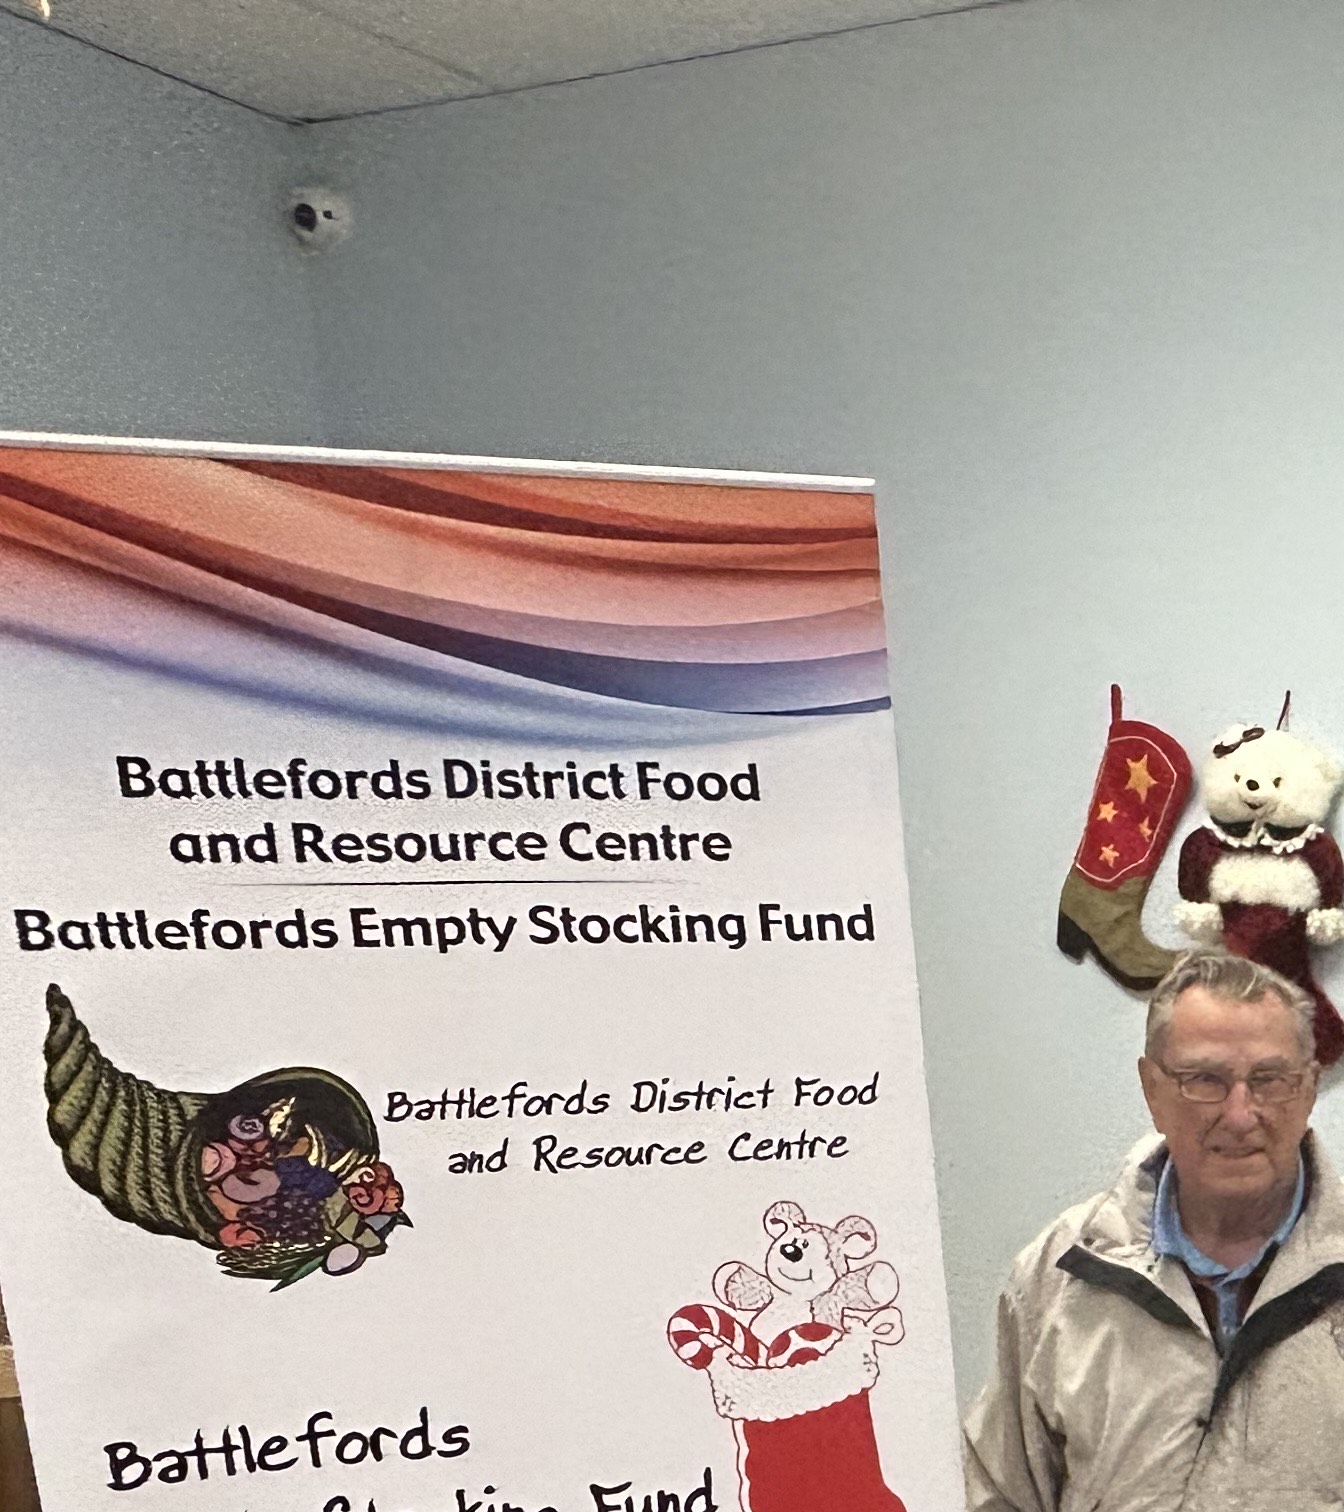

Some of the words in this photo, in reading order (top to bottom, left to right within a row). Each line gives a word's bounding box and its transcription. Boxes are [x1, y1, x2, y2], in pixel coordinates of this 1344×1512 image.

[115, 755, 432, 801] Battlefords
[442, 758, 627, 801] District
[635, 761, 761, 802] Food
[169, 821, 279, 864] and
[291, 822, 548, 864] Resource
[559, 821, 732, 862] Centre
[13, 908, 339, 952] Battlefords
[349, 907, 518, 954] Empty
[528, 904, 747, 950] Stocking
[758, 903, 875, 942] Fund
[383, 1079, 611, 1123] Battlefords
[630, 1075, 775, 1114] District
[794, 1071, 880, 1107] Food
[448, 1137, 509, 1175] and
[532, 1134, 708, 1174] Resource
[727, 1128, 850, 1162] Centre
[103, 1406, 470, 1492] Battlefords
